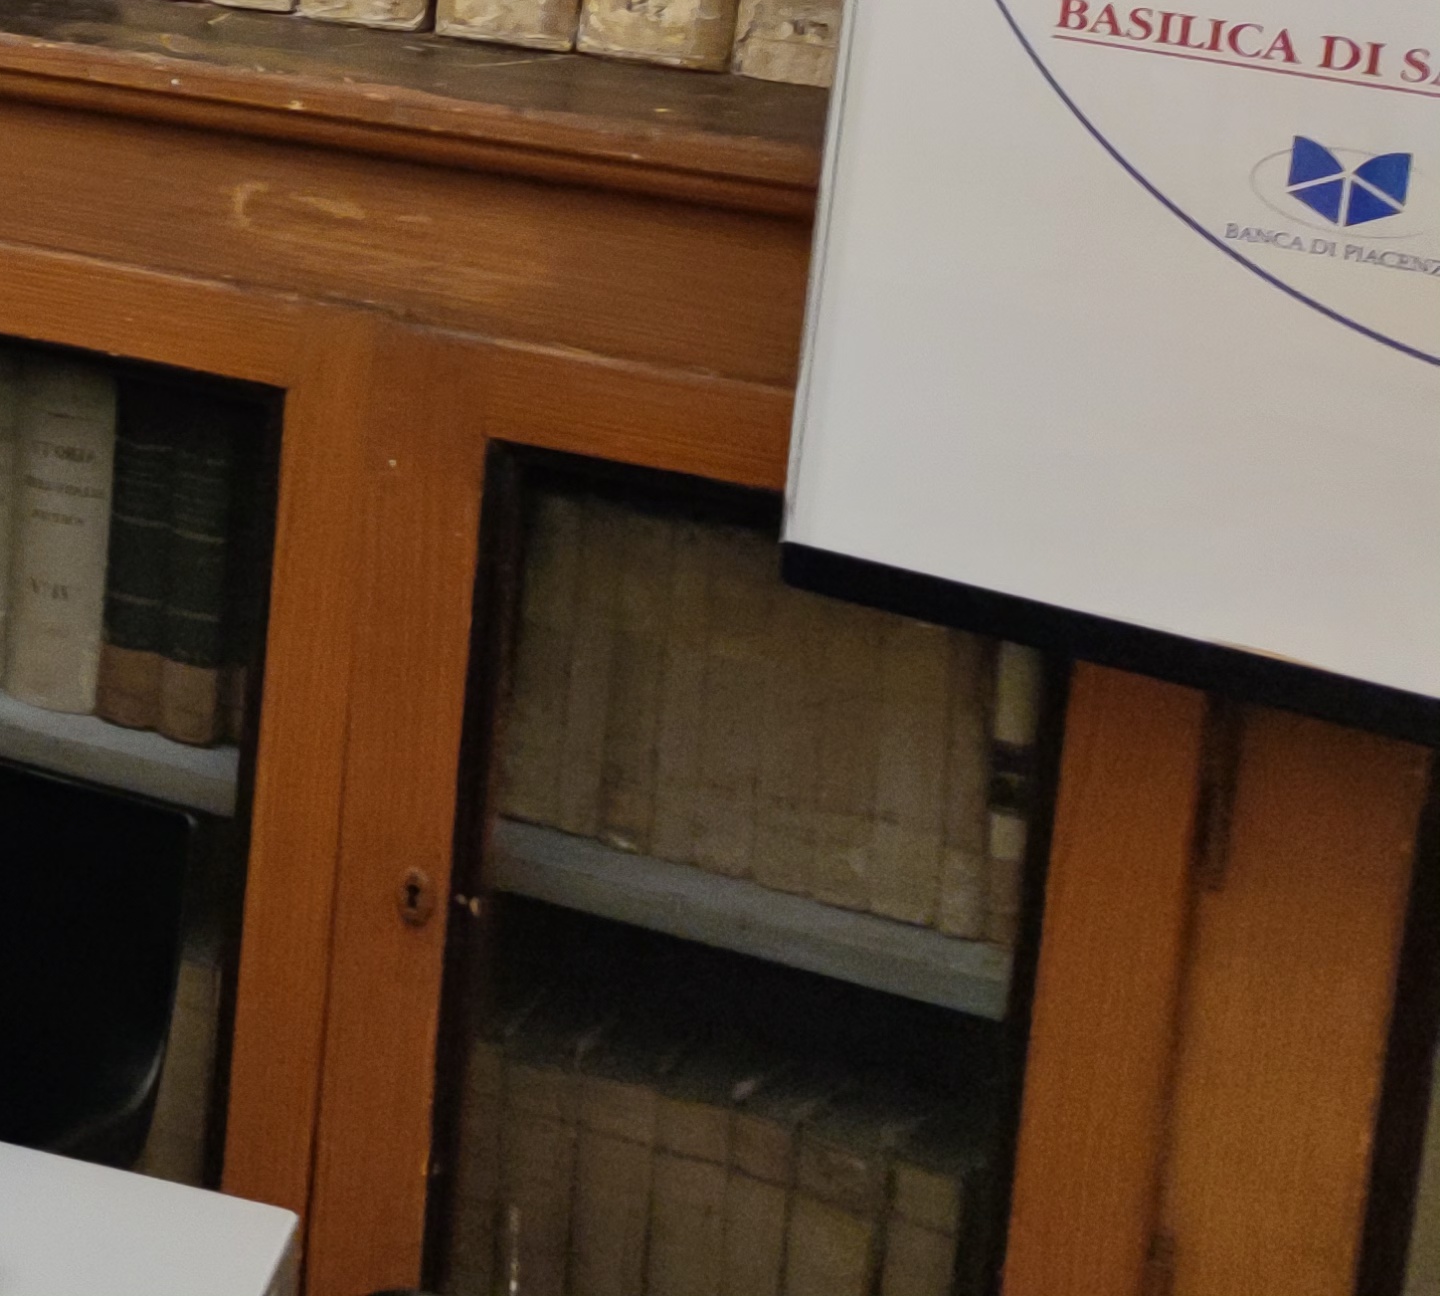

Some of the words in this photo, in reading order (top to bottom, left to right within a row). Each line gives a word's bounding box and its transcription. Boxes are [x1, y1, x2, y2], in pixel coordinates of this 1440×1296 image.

[1318, 35, 1386, 76] DI
[1224, 222, 1305, 254] BANCA
[1309, 237, 1337, 259] DI
